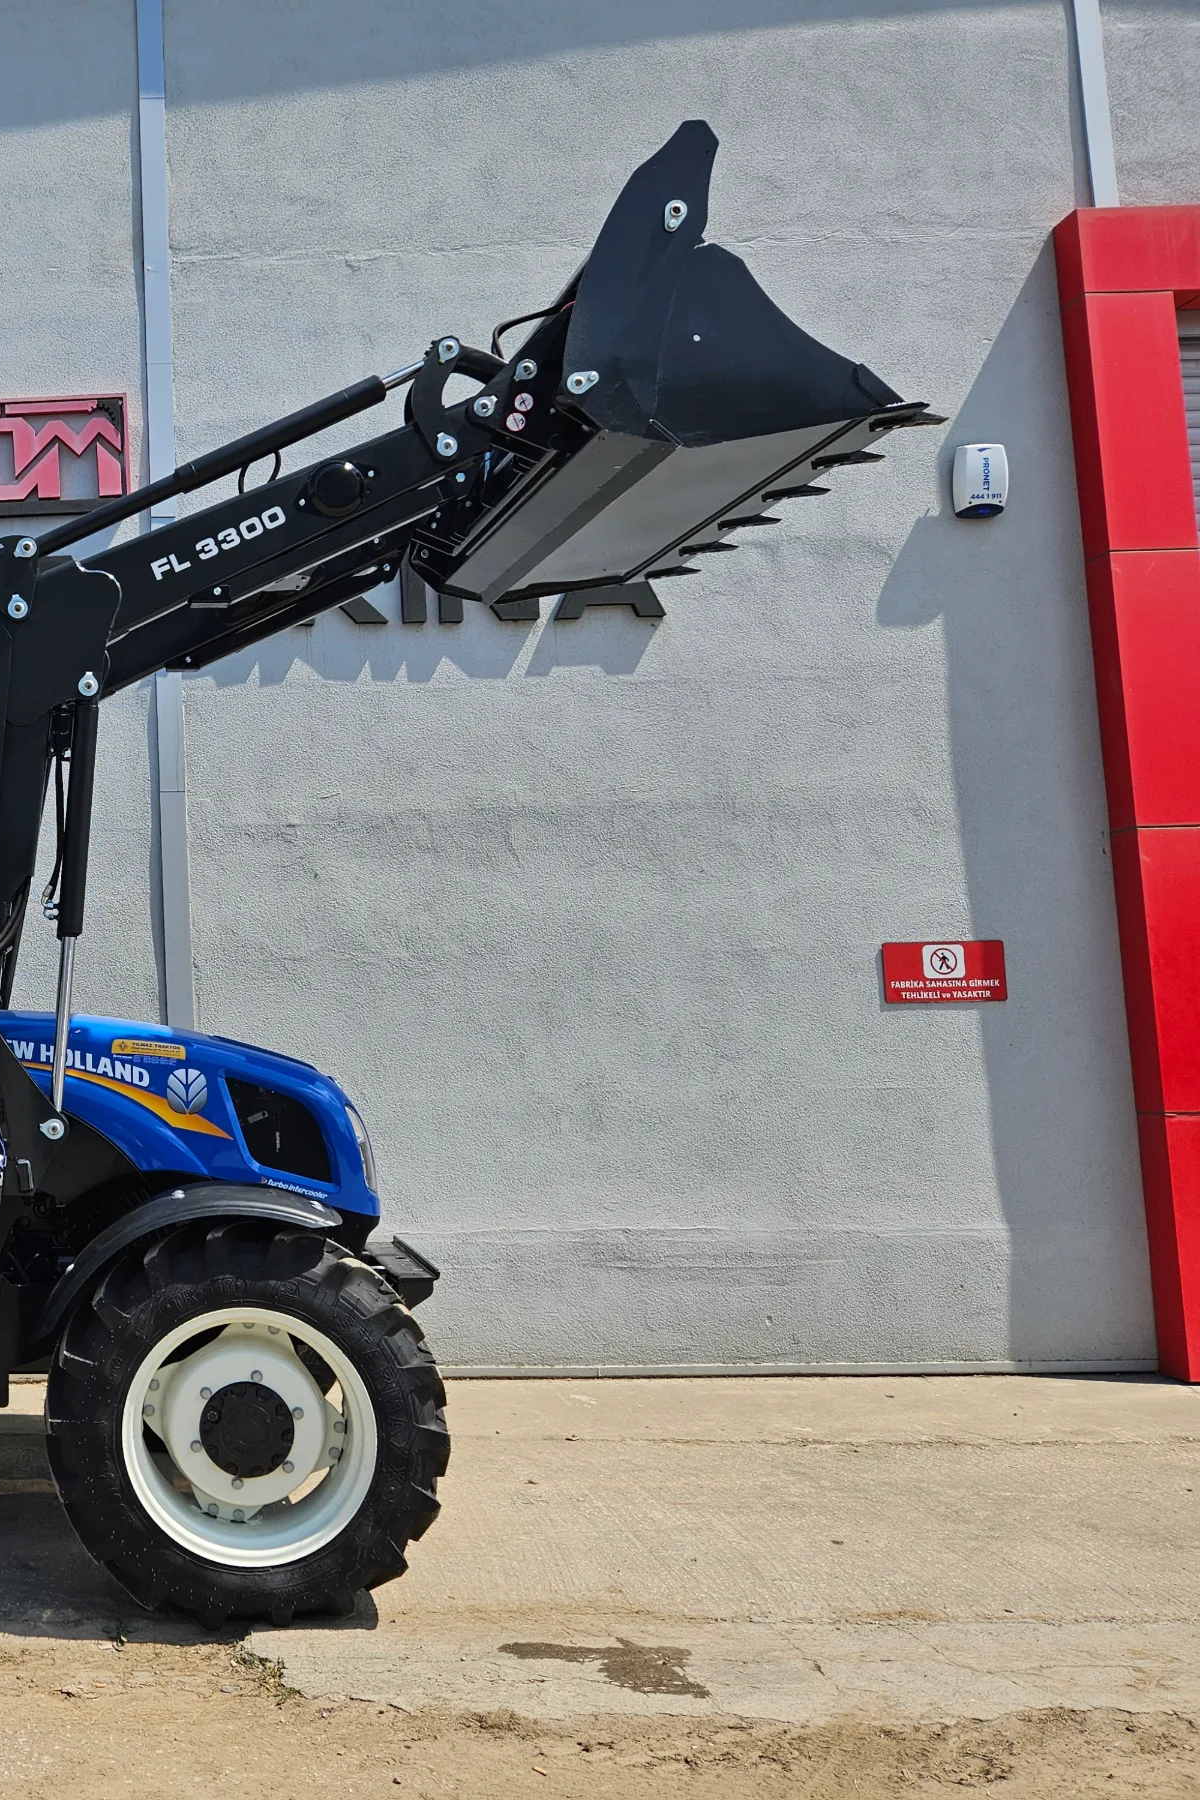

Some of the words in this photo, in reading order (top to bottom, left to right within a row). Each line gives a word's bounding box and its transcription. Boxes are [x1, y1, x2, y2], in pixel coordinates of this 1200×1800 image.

[982, 457, 990, 491] PRONET
[150, 553, 192, 582] FL
[195, 505, 287, 561] 3300
[891, 979, 924, 989] FABRİKA
[926, 978, 968, 988] SAHASINA
[969, 977, 1000, 987] GİRMEK
[901, 990, 940, 999] TEHLİKELİ
[942, 991, 951, 999] ve
[952, 990, 992, 998] YASAKTIR
[267, 1178, 289, 1190] turbo
[288, 1184, 328, 1199] intercooler
